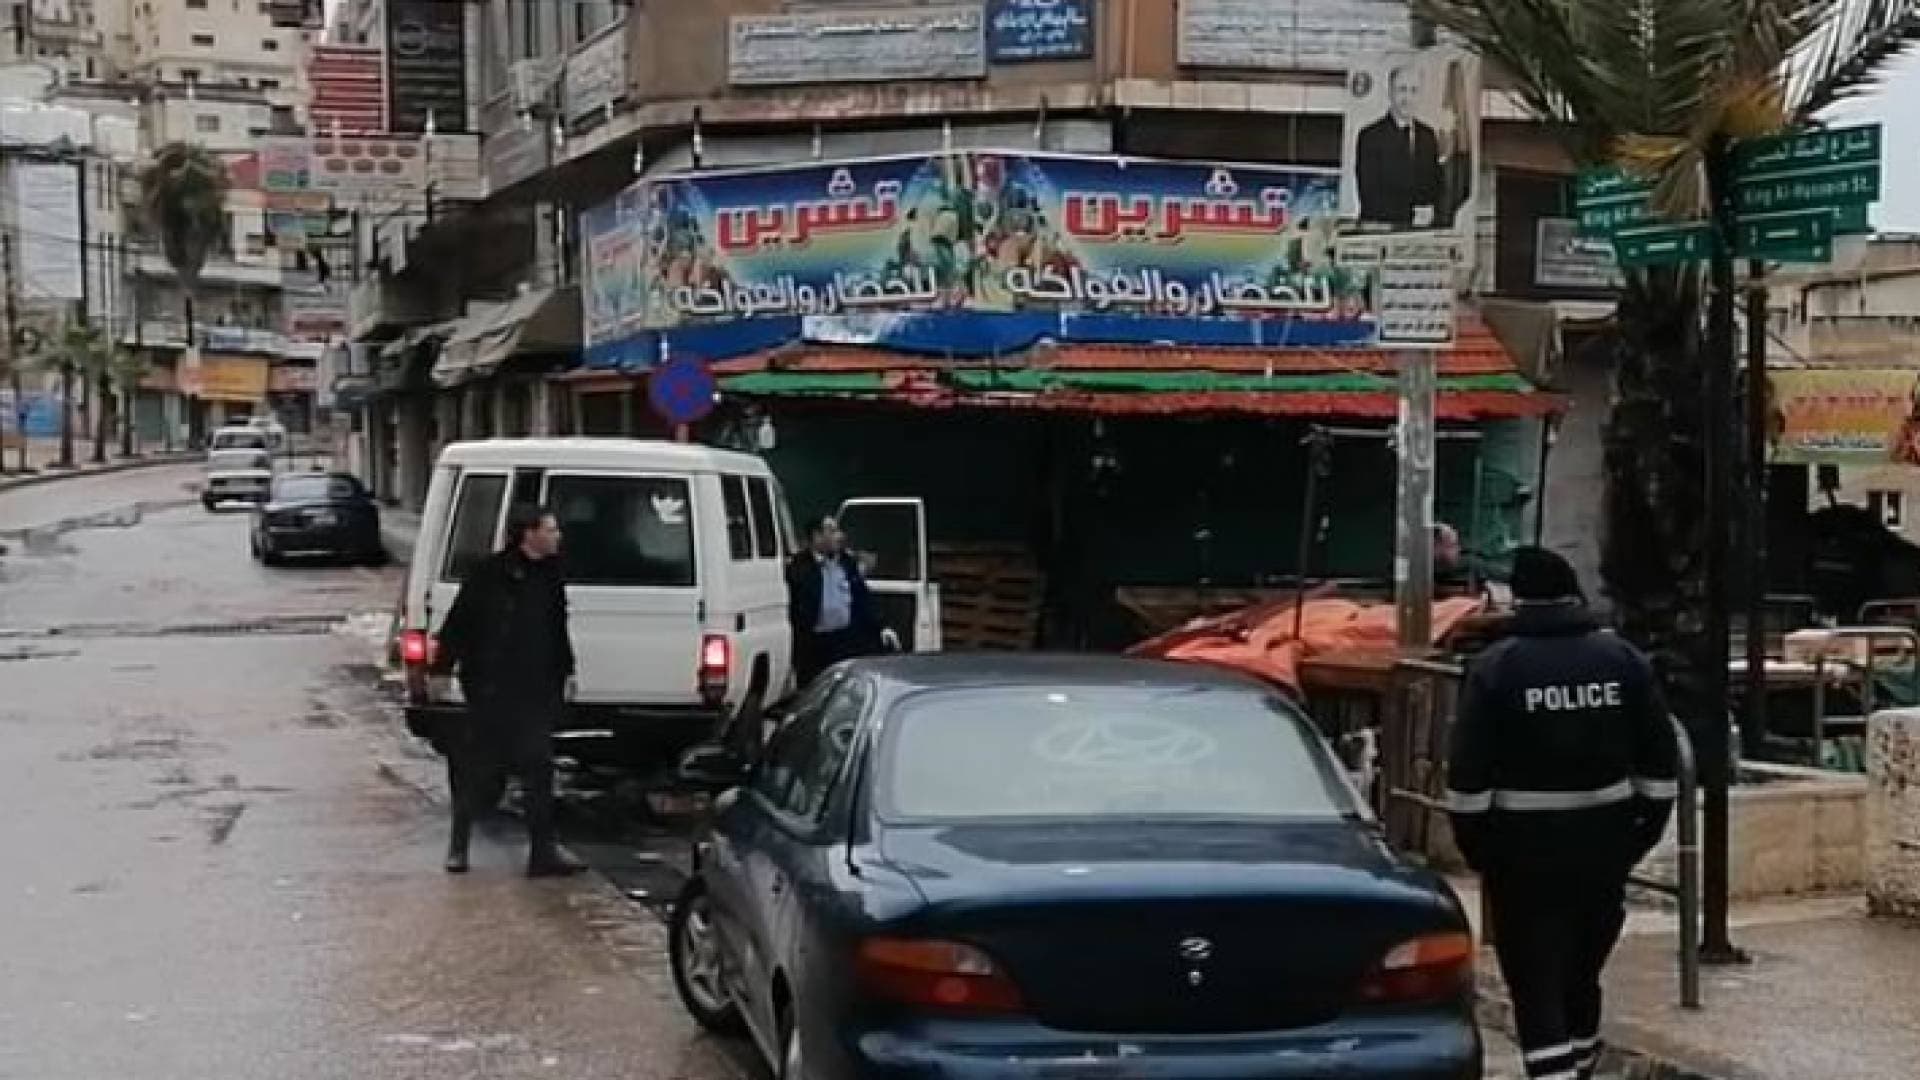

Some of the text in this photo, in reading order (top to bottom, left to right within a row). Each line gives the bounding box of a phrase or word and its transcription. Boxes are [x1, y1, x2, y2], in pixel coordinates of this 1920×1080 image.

[716, 168, 903, 252] تشرين
[1063, 168, 1293, 243] تشرين
[1525, 681, 1622, 712] POLICE
